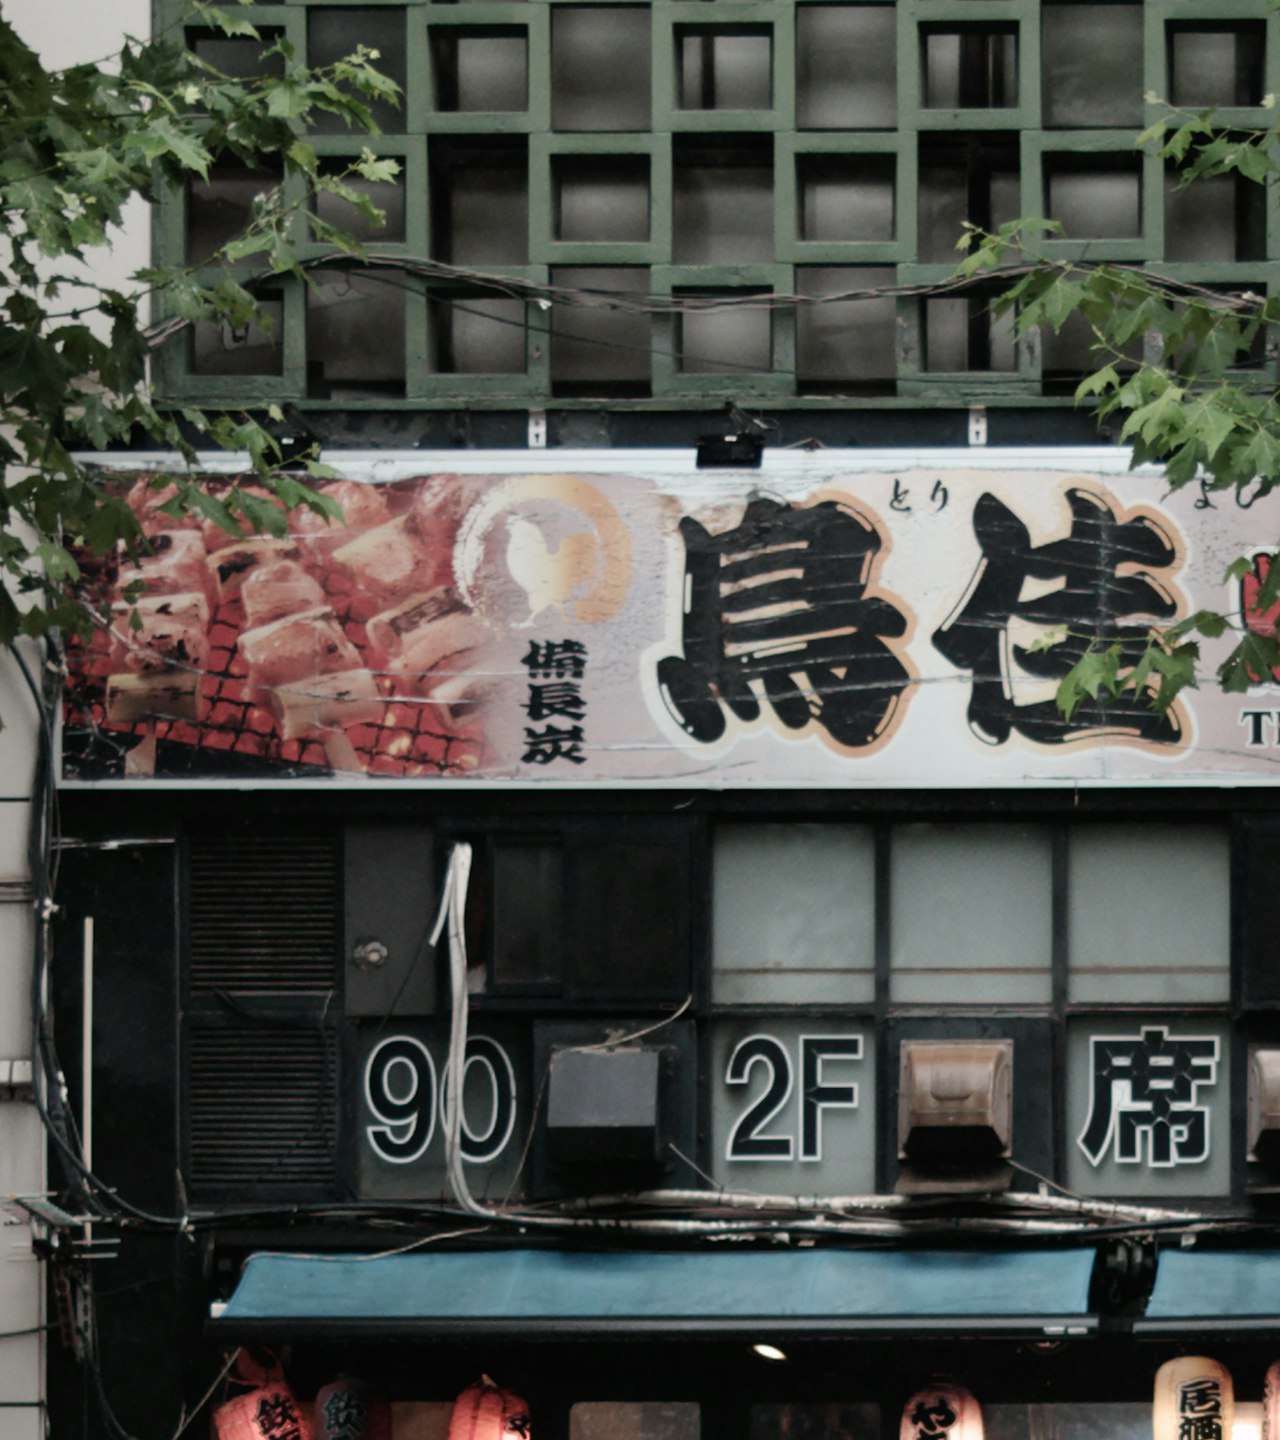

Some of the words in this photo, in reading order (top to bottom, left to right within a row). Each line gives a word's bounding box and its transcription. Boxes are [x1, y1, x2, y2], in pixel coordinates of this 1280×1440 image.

[889, 478, 950, 512] とり
[521, 638, 588, 767] 備長炭
[364, 1034, 517, 1164] 90
[724, 1033, 865, 1162] 2F
[1076, 1025, 1221, 1168] 席
